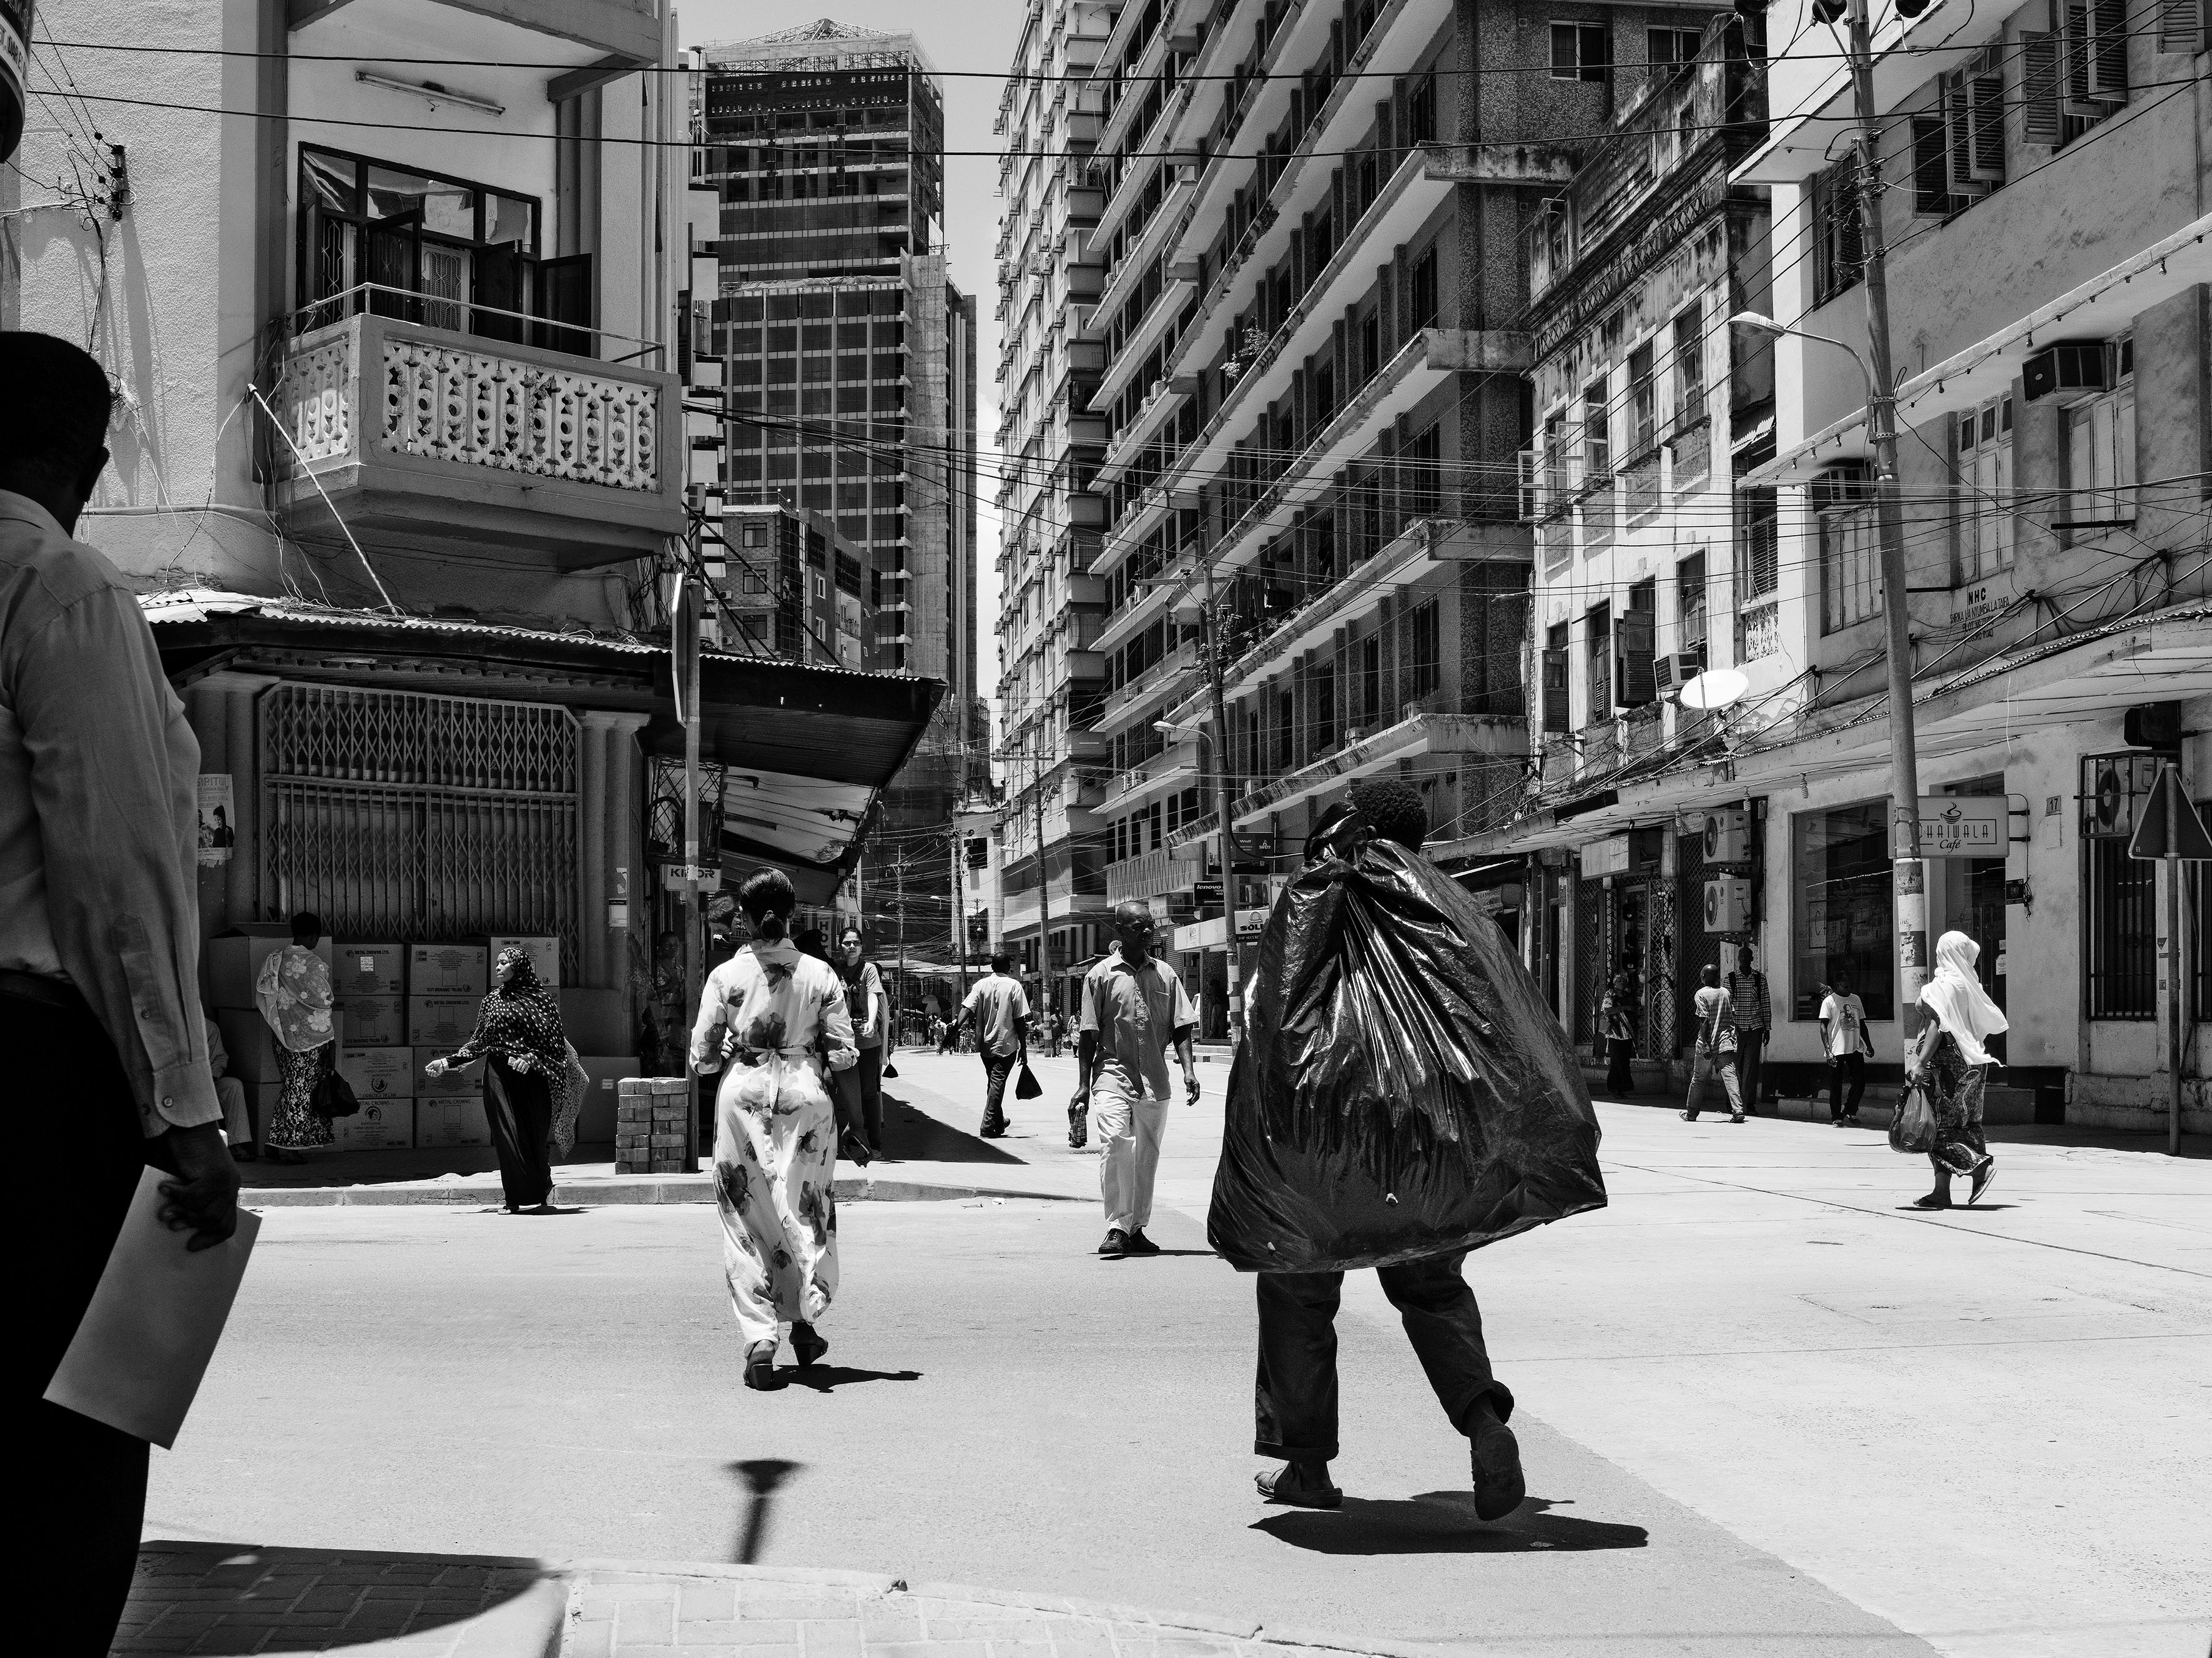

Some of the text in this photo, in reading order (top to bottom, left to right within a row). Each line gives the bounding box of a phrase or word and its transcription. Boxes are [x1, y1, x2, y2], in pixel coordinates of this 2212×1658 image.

[1969, 588, 1986, 605] NHC
[2050, 797, 2058, 811] 17
[1939, 839, 1962, 853] Café
